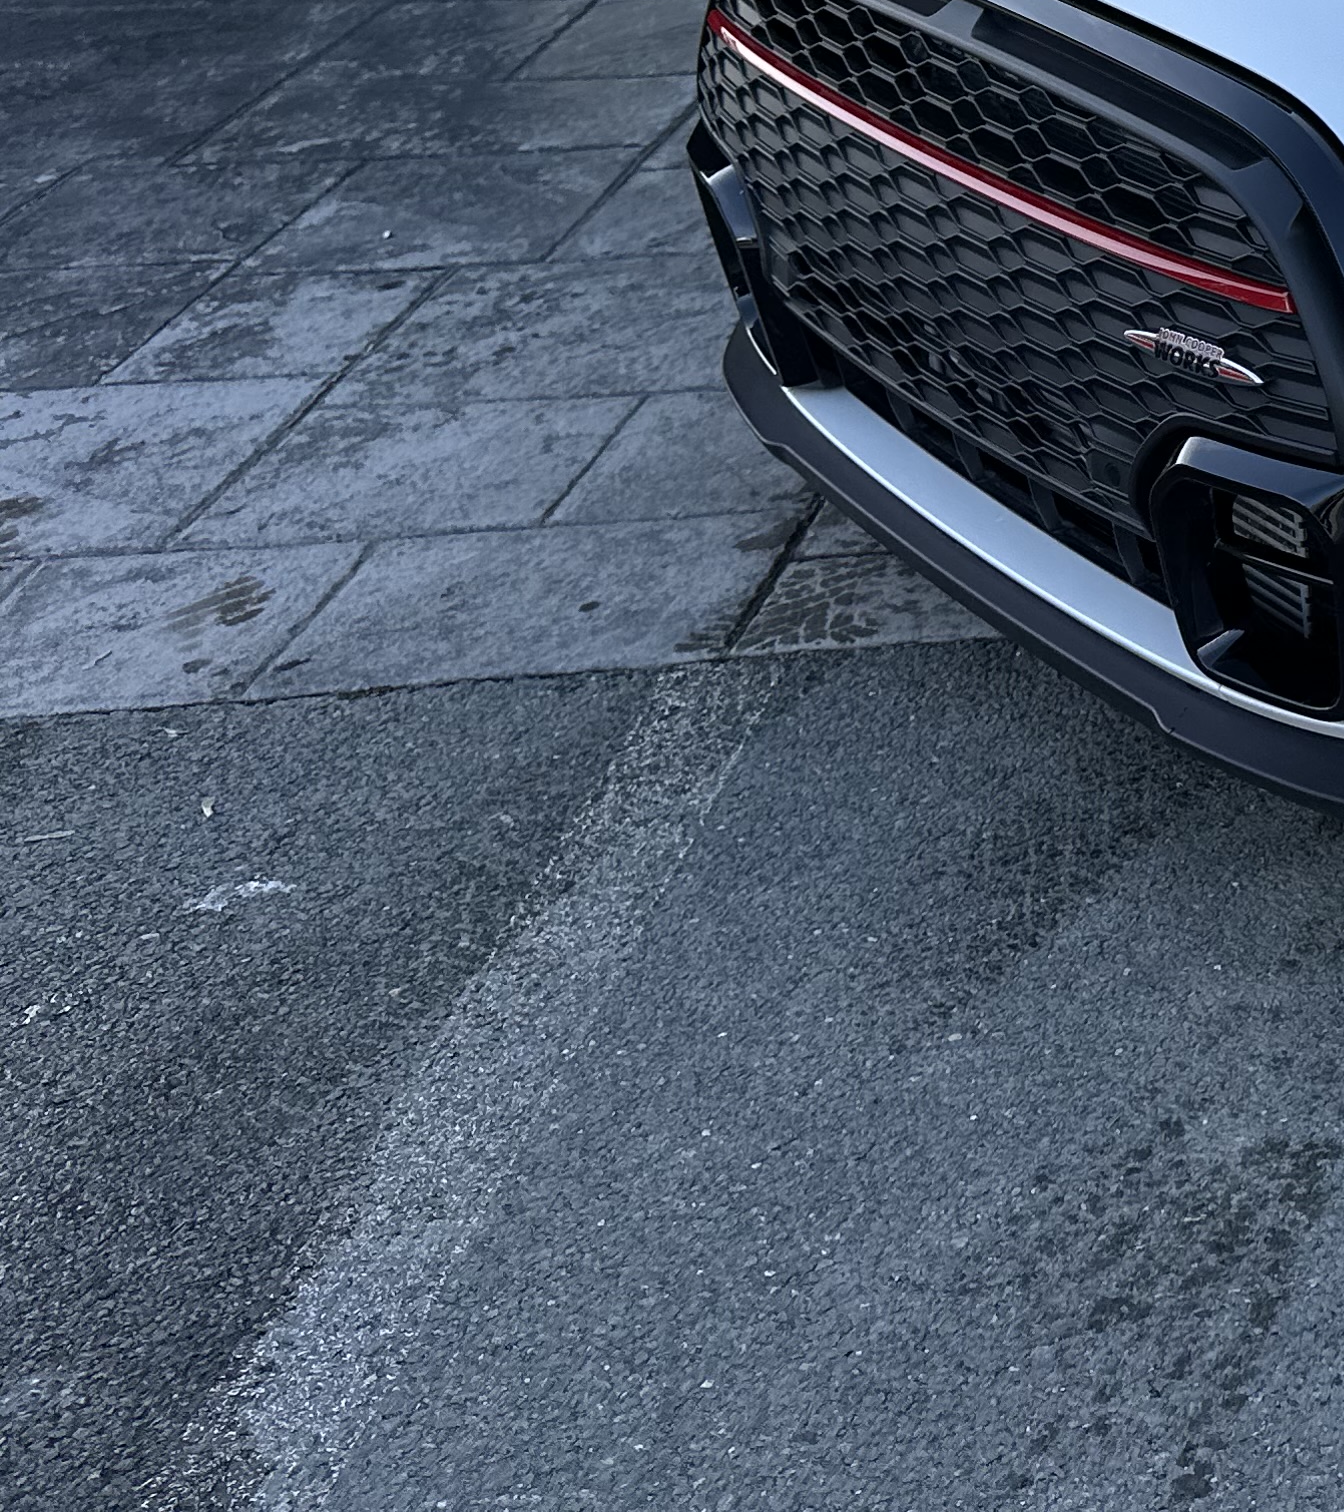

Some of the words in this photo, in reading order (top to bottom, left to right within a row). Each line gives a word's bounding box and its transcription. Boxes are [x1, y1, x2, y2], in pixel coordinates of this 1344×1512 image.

[1154, 340, 1220, 378] WORKS
[1158, 327, 1185, 345] JOHN
[1185, 336, 1225, 360] COOPER
